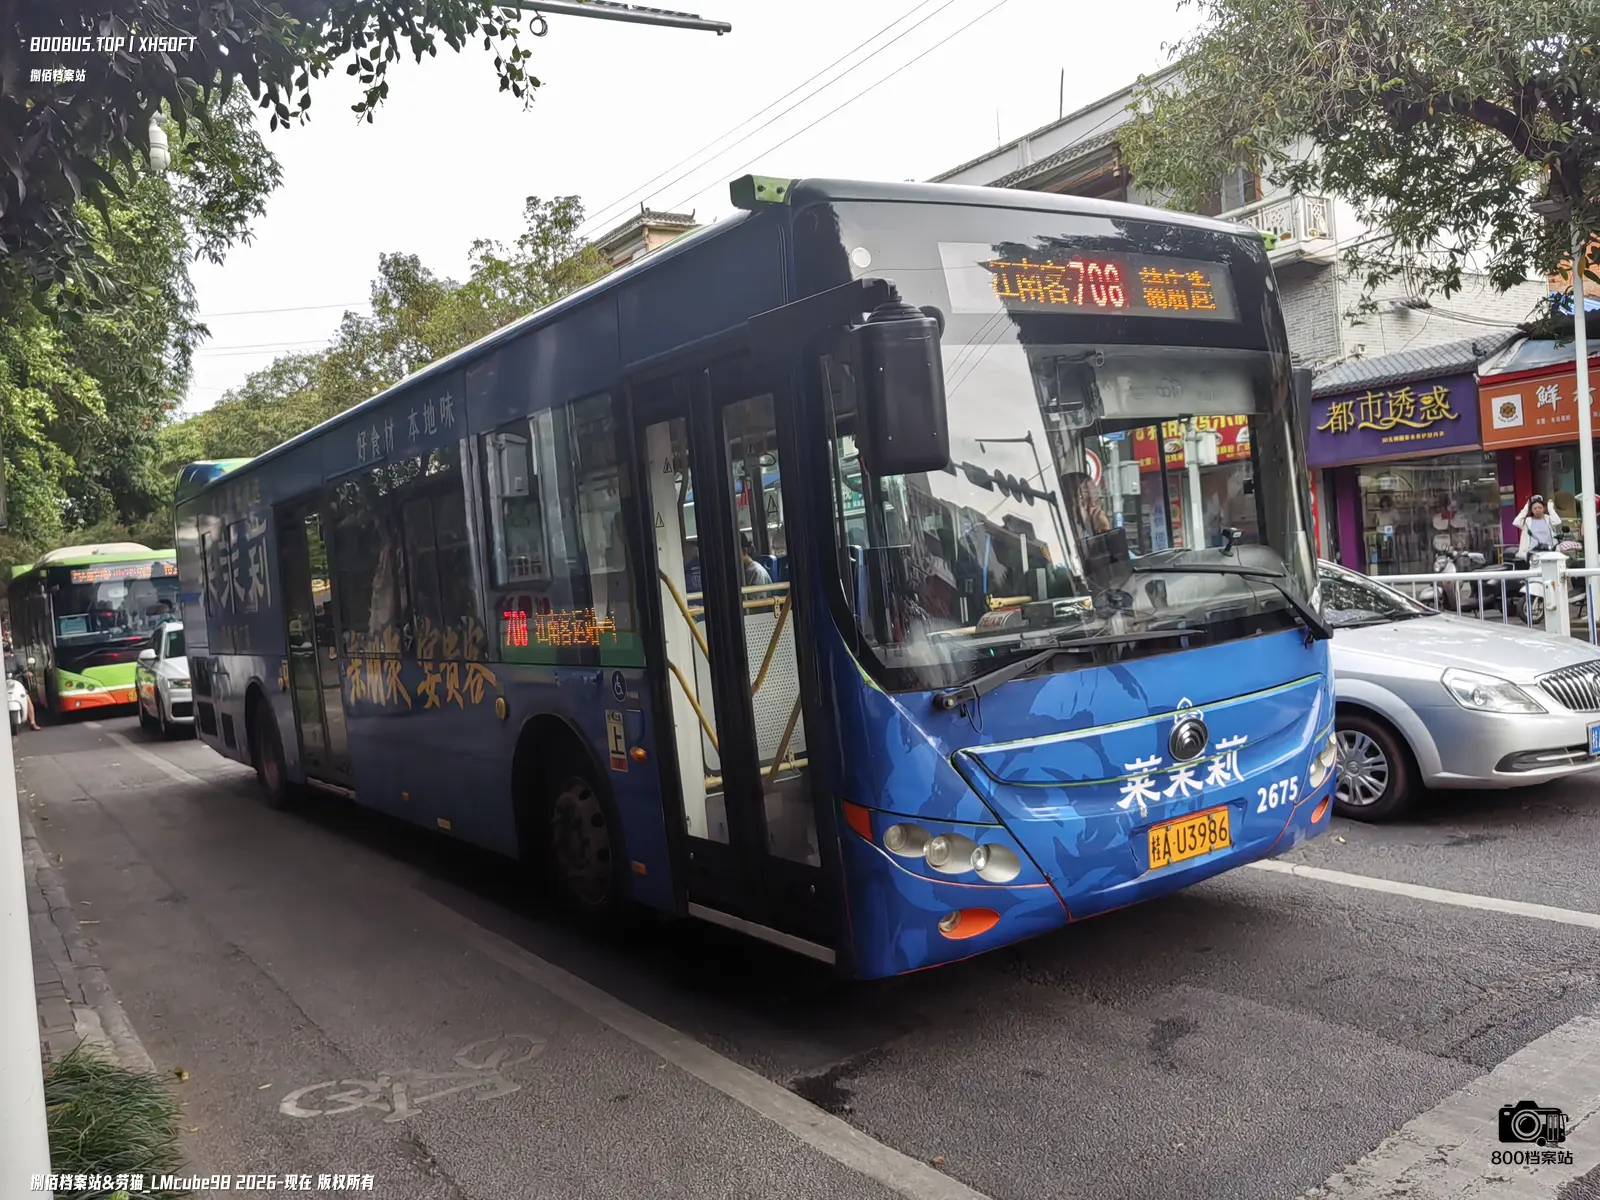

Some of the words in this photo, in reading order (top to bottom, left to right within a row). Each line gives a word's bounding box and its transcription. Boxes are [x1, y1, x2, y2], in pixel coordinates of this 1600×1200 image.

[1068, 259, 1125, 308] 708
[356, 416, 395, 463] 好食材
[407, 390, 456, 443] 本地味
[1317, 385, 1459, 434] 都市诱惑
[1256, 776, 1299, 814] 2675
